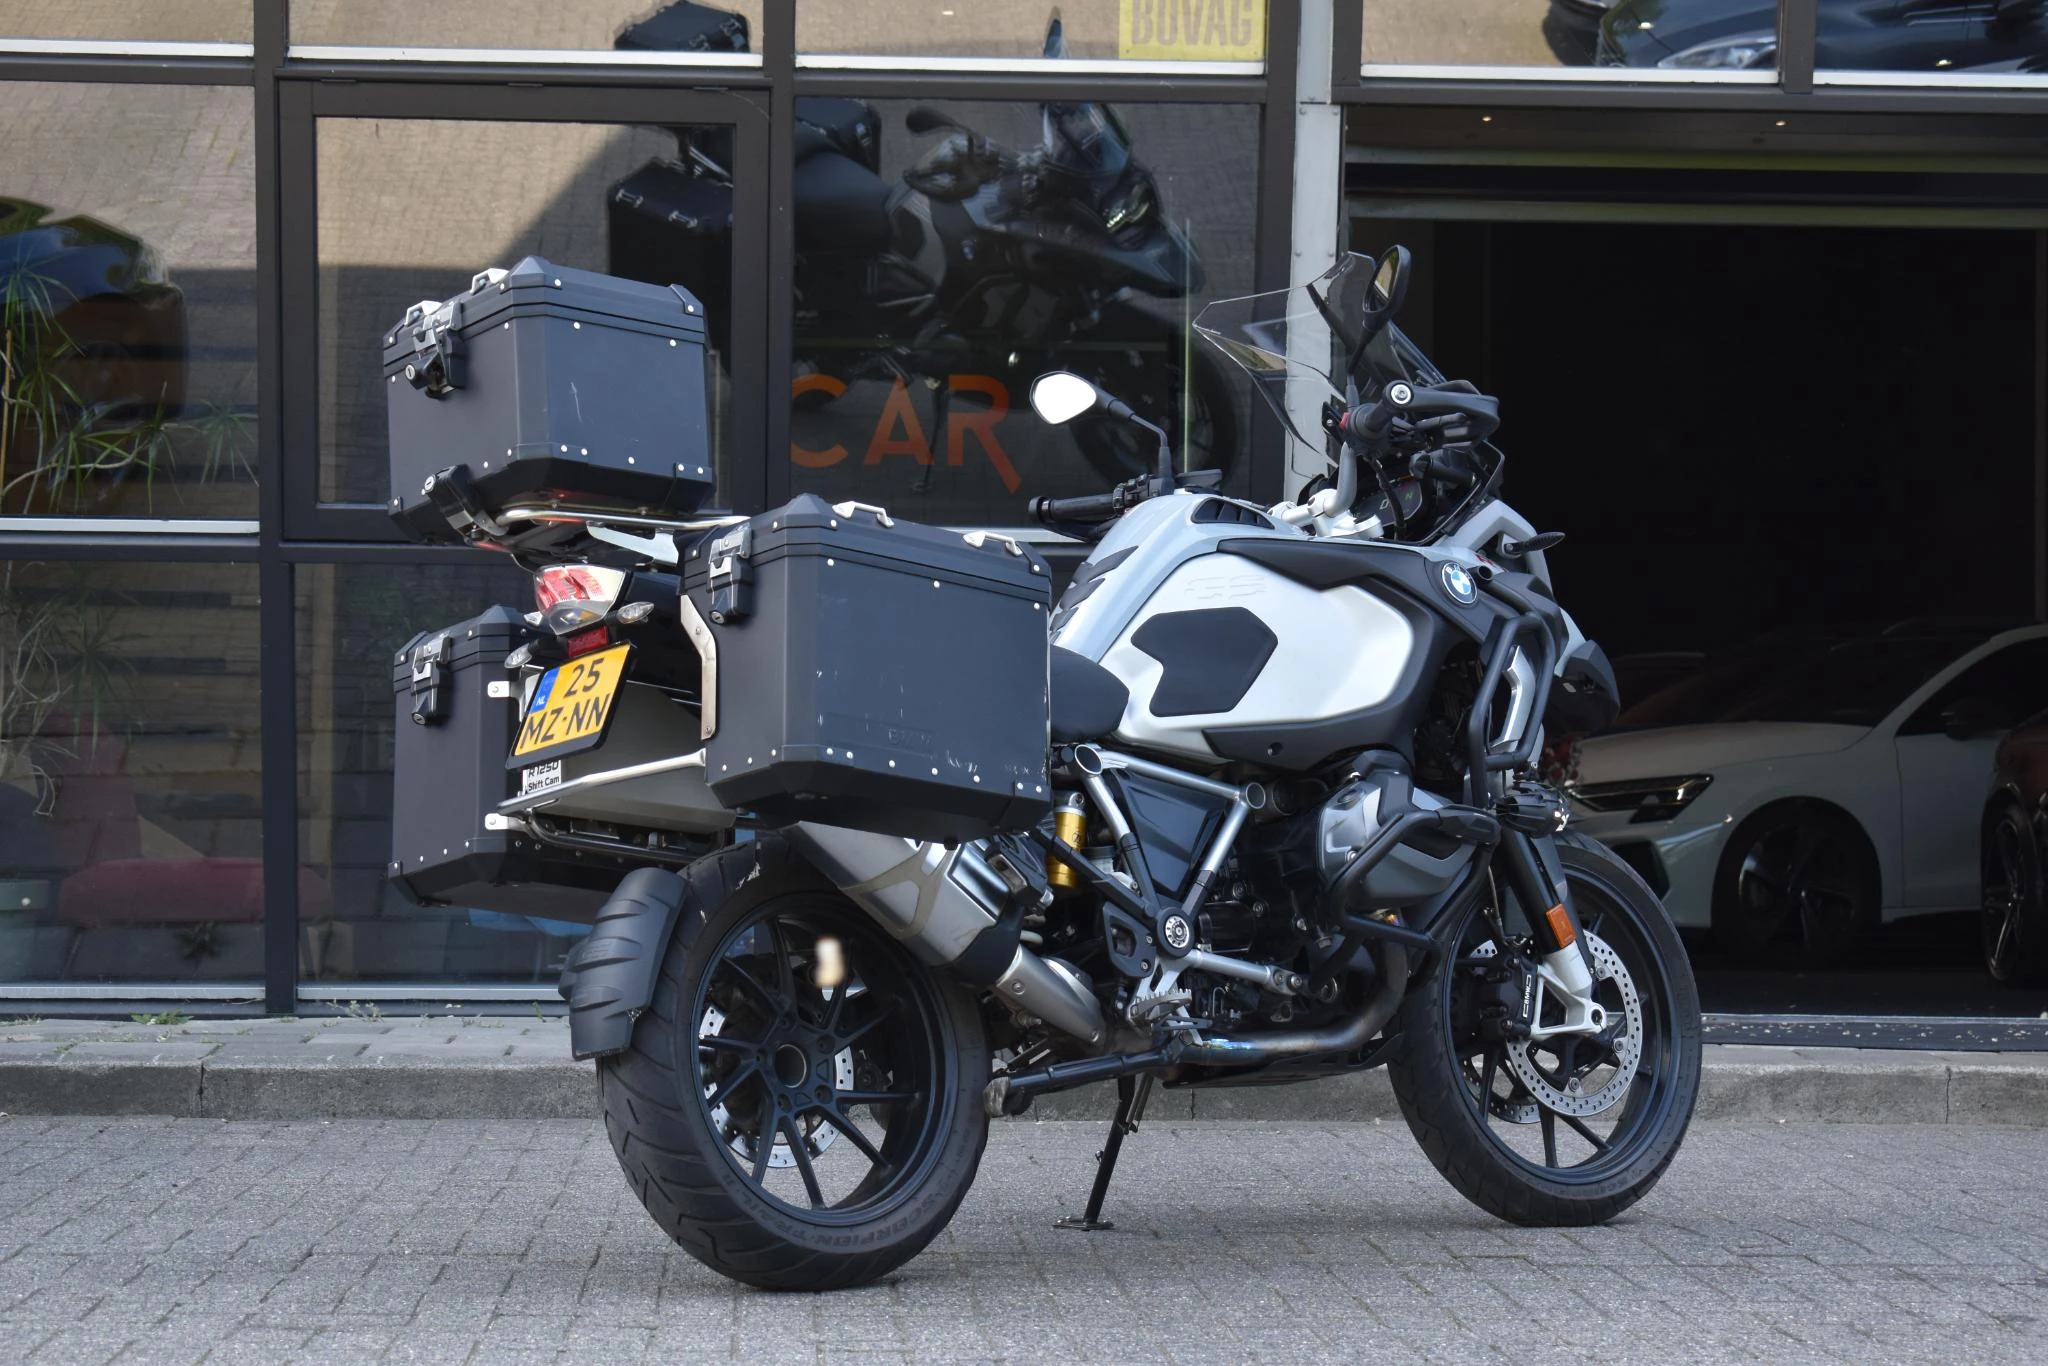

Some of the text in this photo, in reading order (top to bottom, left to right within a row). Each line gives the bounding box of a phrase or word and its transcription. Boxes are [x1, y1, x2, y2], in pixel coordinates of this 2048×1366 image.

[1131, 0, 1253, 46] BOVAG
[791, 373, 1022, 495] CAR
[563, 657, 605, 699] 25
[535, 695, 546, 706] NL
[528, 776, 560, 792] Shift Cam
